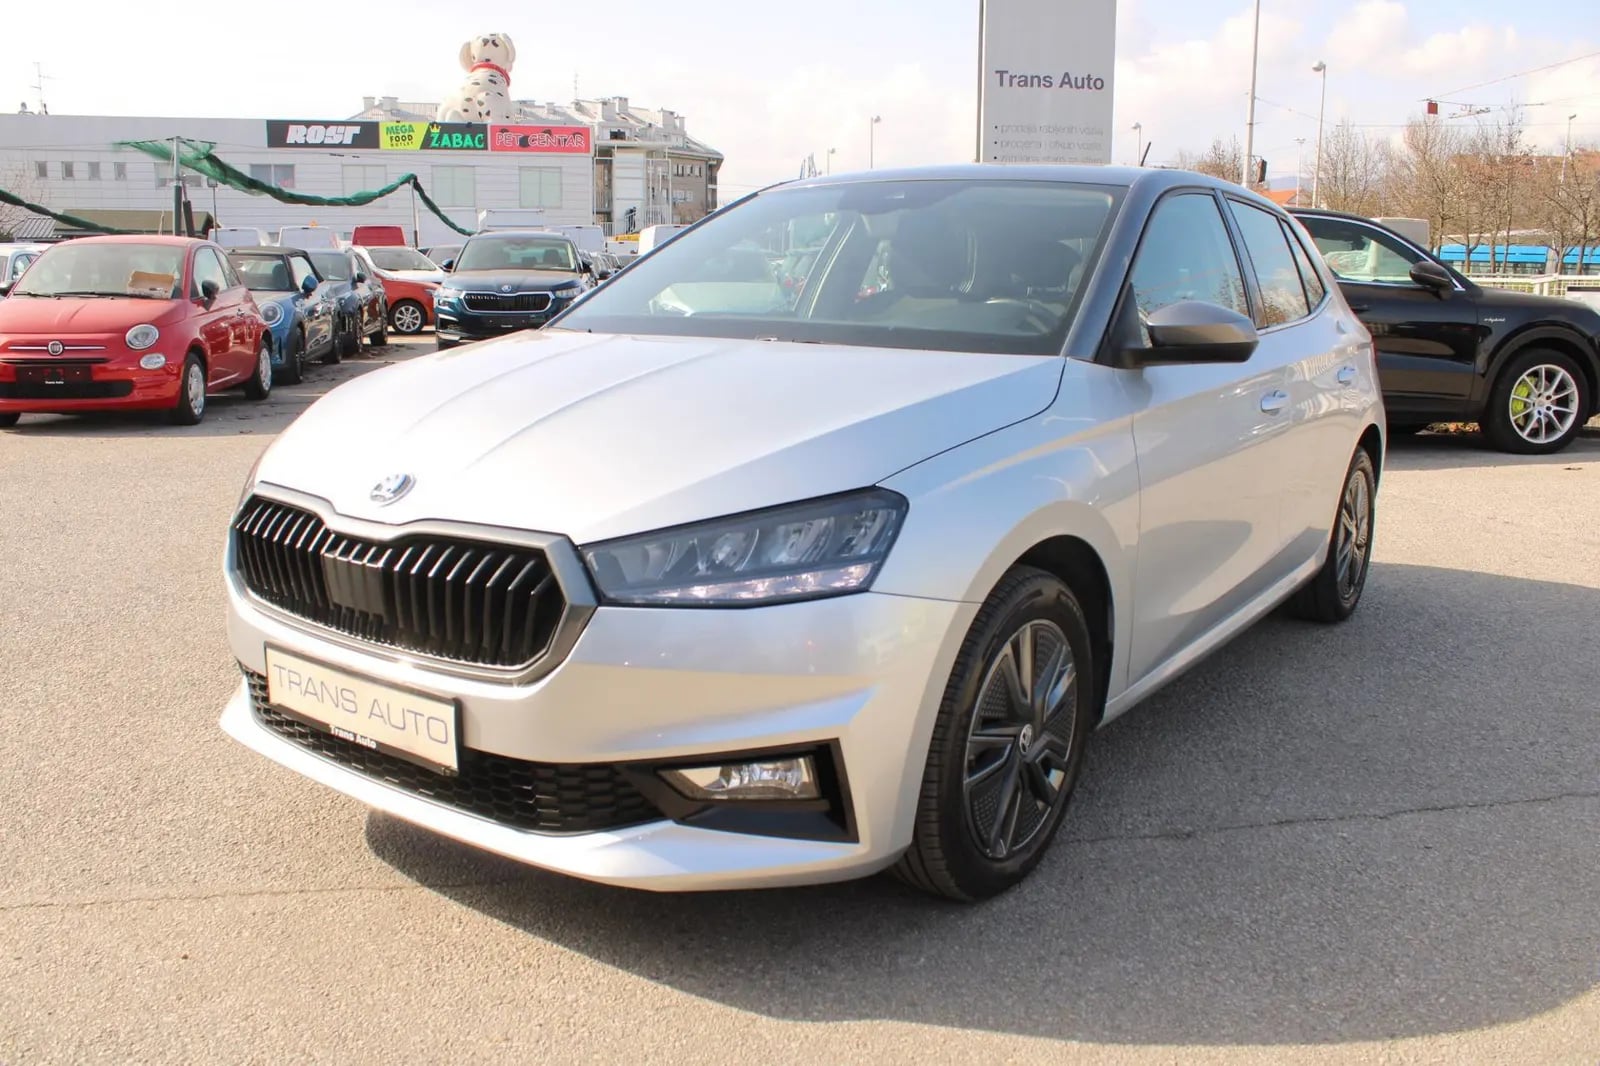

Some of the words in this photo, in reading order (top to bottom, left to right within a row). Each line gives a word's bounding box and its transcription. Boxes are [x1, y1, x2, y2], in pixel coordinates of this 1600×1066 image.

[994, 69, 1053, 88] Trans
[1058, 71, 1105, 90] Auto
[285, 124, 361, 144] ROST
[386, 124, 415, 136] MEGA
[389, 134, 414, 143] FOOD
[495, 132, 522, 147] PET
[527, 133, 585, 148] CENTAR
[273, 663, 358, 715] TRANS
[367, 697, 449, 744] AUTO
